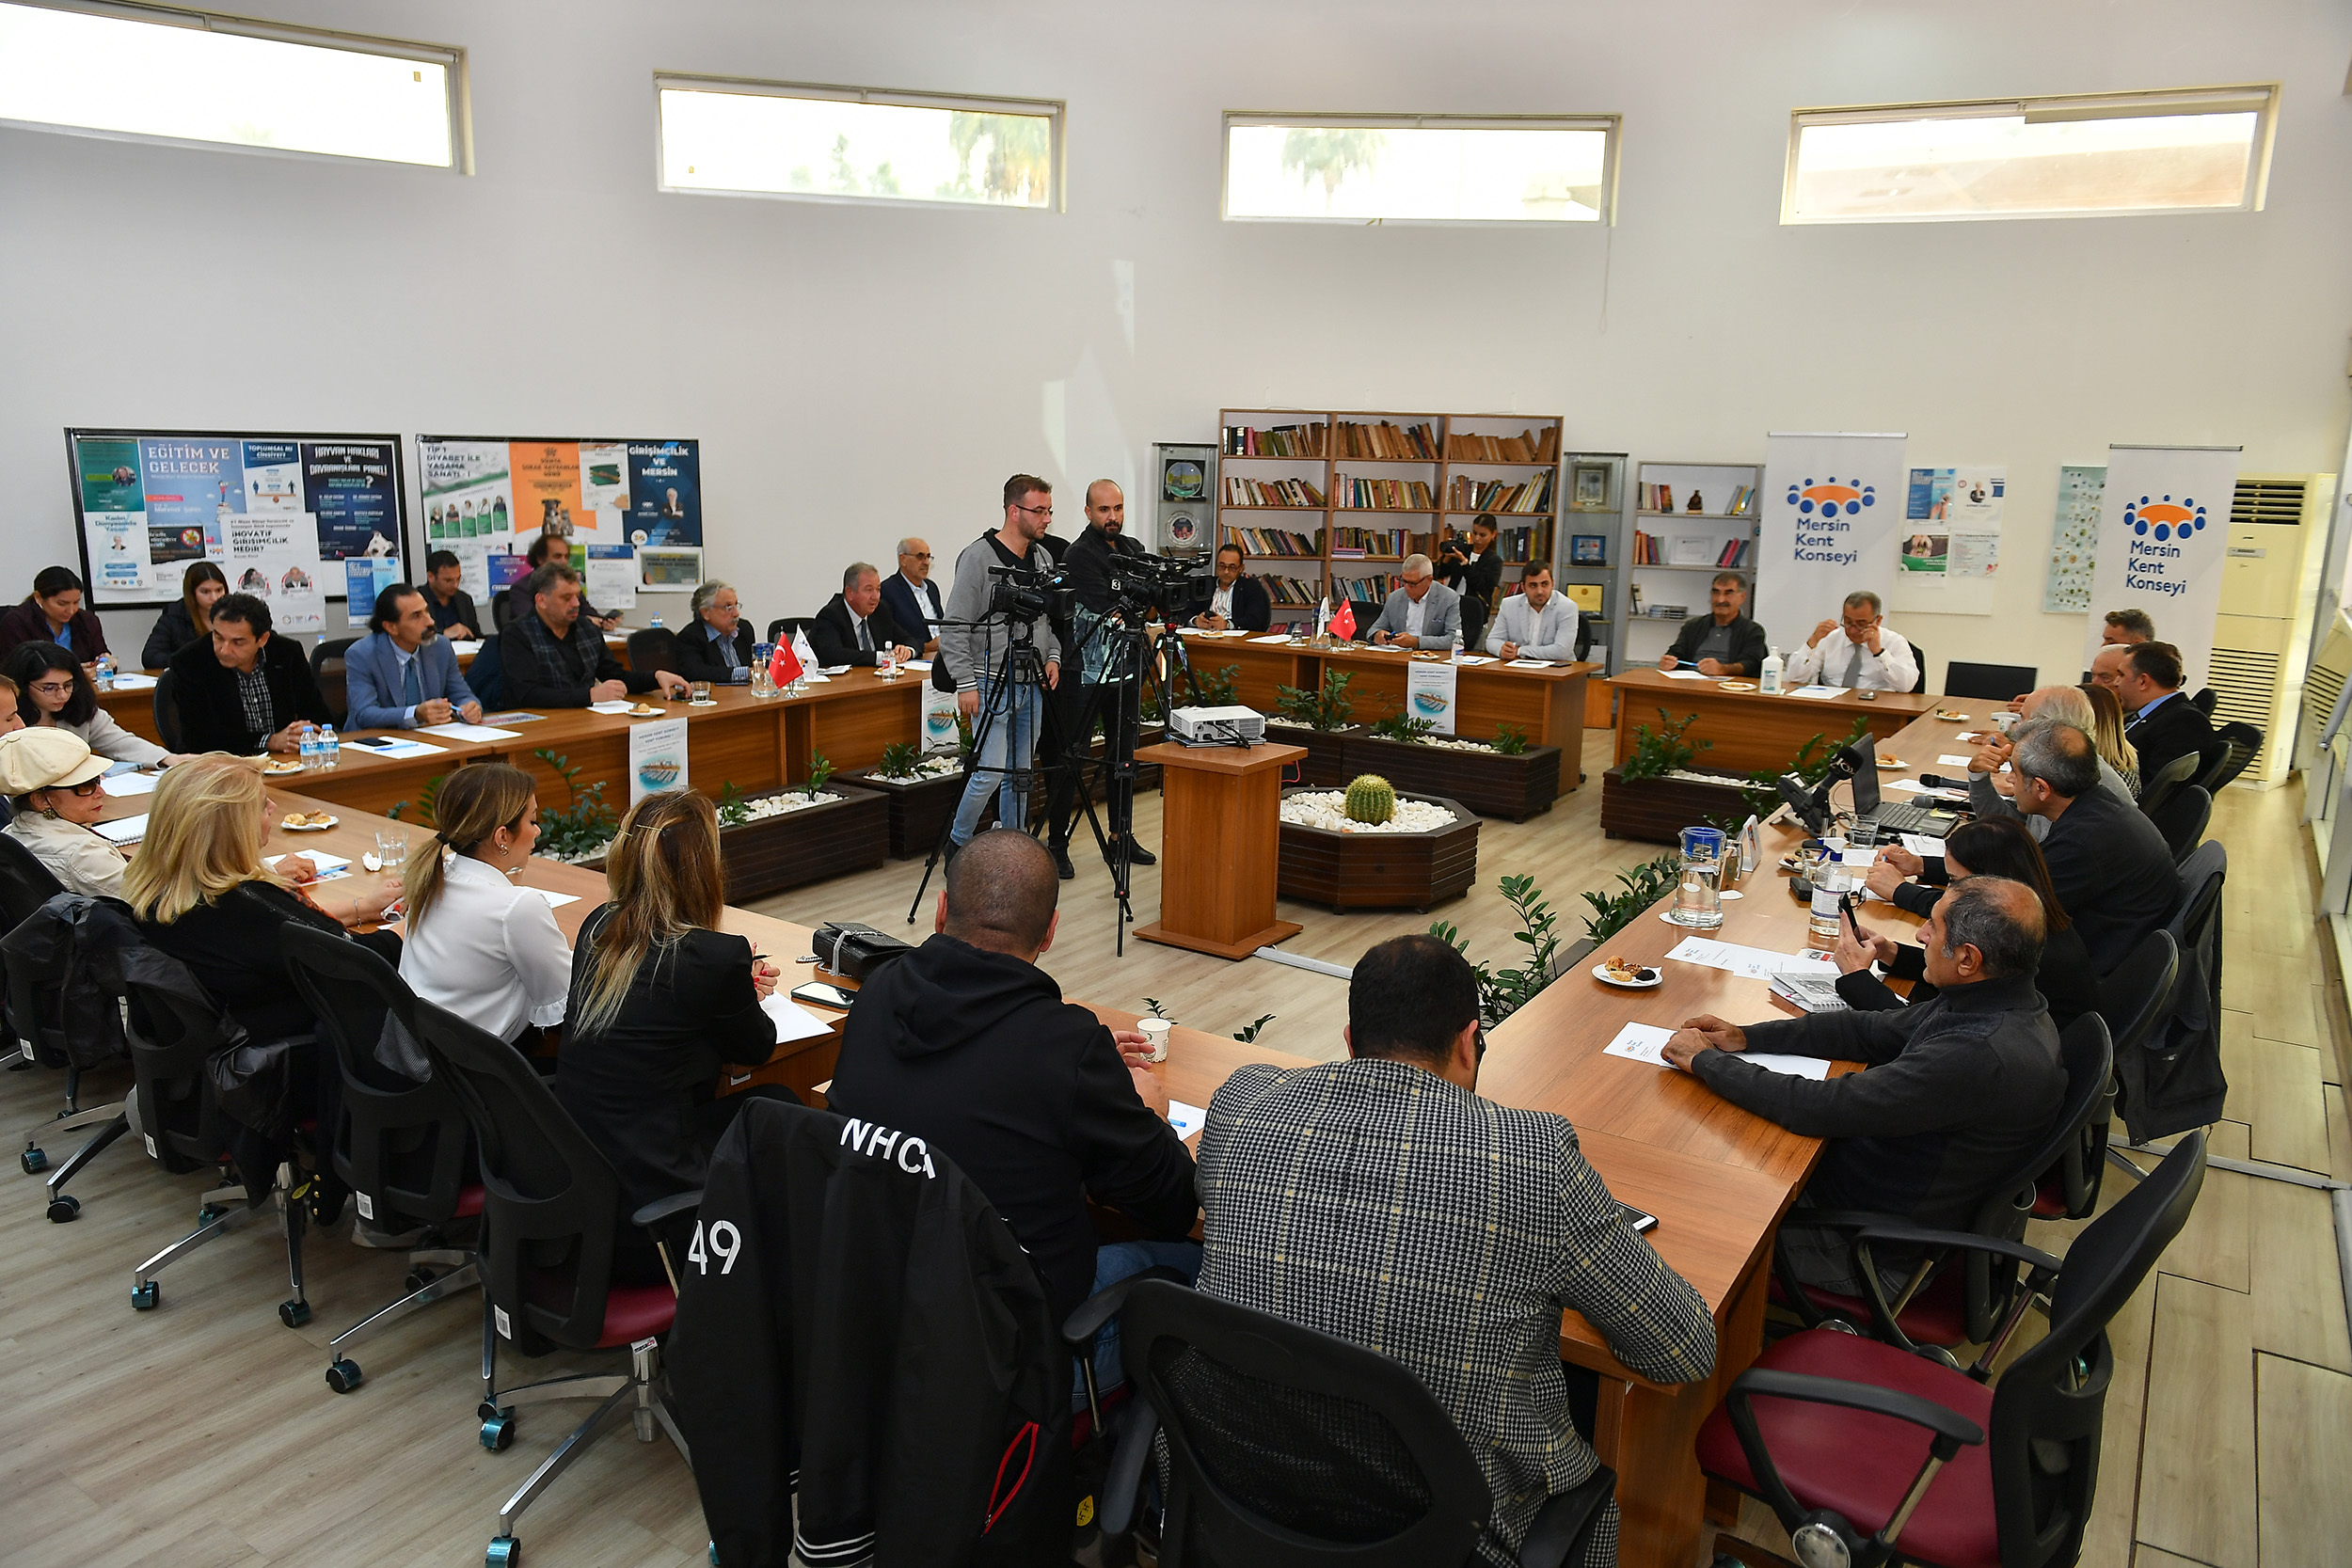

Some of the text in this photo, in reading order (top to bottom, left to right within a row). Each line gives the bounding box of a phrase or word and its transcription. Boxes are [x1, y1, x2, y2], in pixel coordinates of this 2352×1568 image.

[148, 443, 230, 460] EĞİTİM VE
[315, 446, 346, 459] HAYVAN
[467, 452, 481, 461] İLE
[628, 444, 690, 457] GİRİŞİMCİLİK
[343, 455, 353, 464] VE
[652, 457, 666, 466] VE
[149, 461, 220, 474] GELECEK
[642, 466, 678, 477] MERSİN
[1796, 517, 1851, 531] Mersin
[1795, 532, 1835, 546] Kent
[2130, 540, 2181, 558] Mersin
[1794, 547, 1858, 566] Konseyi
[2128, 557, 2165, 575] Kent
[1113, 579, 1120, 589] 3
[2125, 574, 2186, 597] Konseyi
[688, 1219, 742, 1275] 49
